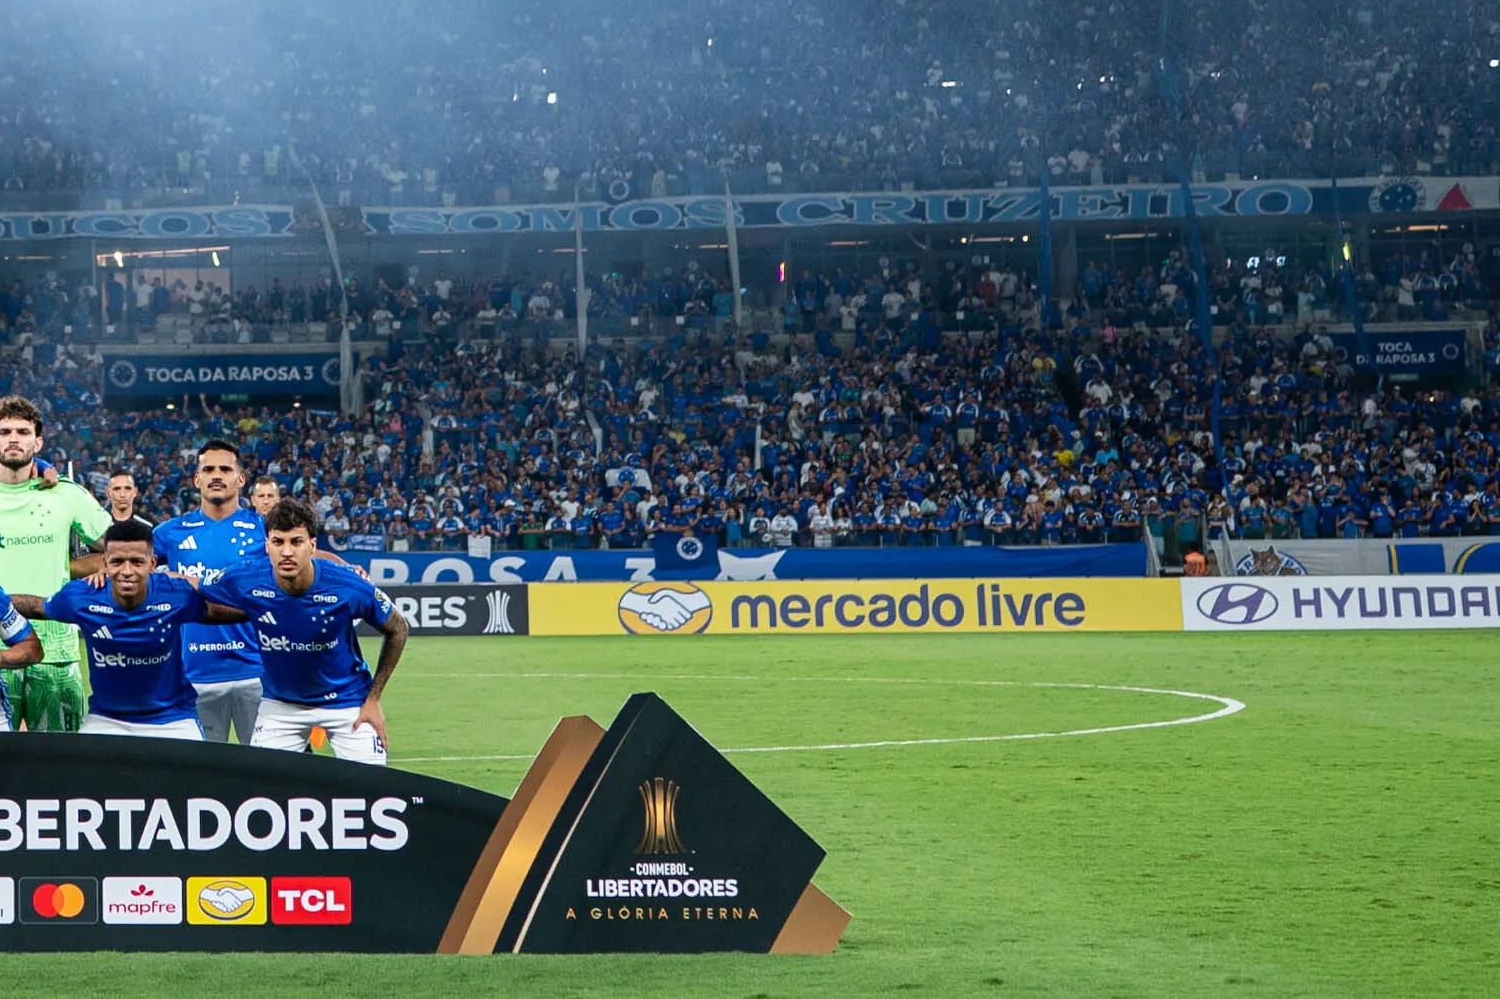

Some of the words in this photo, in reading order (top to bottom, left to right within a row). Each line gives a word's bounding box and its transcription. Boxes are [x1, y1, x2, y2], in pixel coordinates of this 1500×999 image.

[776, 183, 1313, 226] CRUZEIRO
[390, 198, 745, 233] SOMOS
[1378, 342, 1413, 353] TOCA
[1376, 353, 1426, 365] RAPOSA
[1427, 353, 1436, 363] 3
[145, 367, 196, 382] TOCA
[198, 367, 225, 382] DA
[228, 366, 300, 382] RAPOSA
[303, 365, 314, 380] 3
[731, 584, 964, 628] mercado
[978, 583, 1085, 627] livre
[199, 640, 245, 652] PERDIGÃO
[586, 879, 738, 897] LIBERTADORES
[109, 900, 176, 915] mapfre
[278, 889, 345, 912] TCL
[566, 907, 577, 920] A
[590, 905, 669, 920] GLÓRIA
[682, 907, 759, 920] ETERNA
